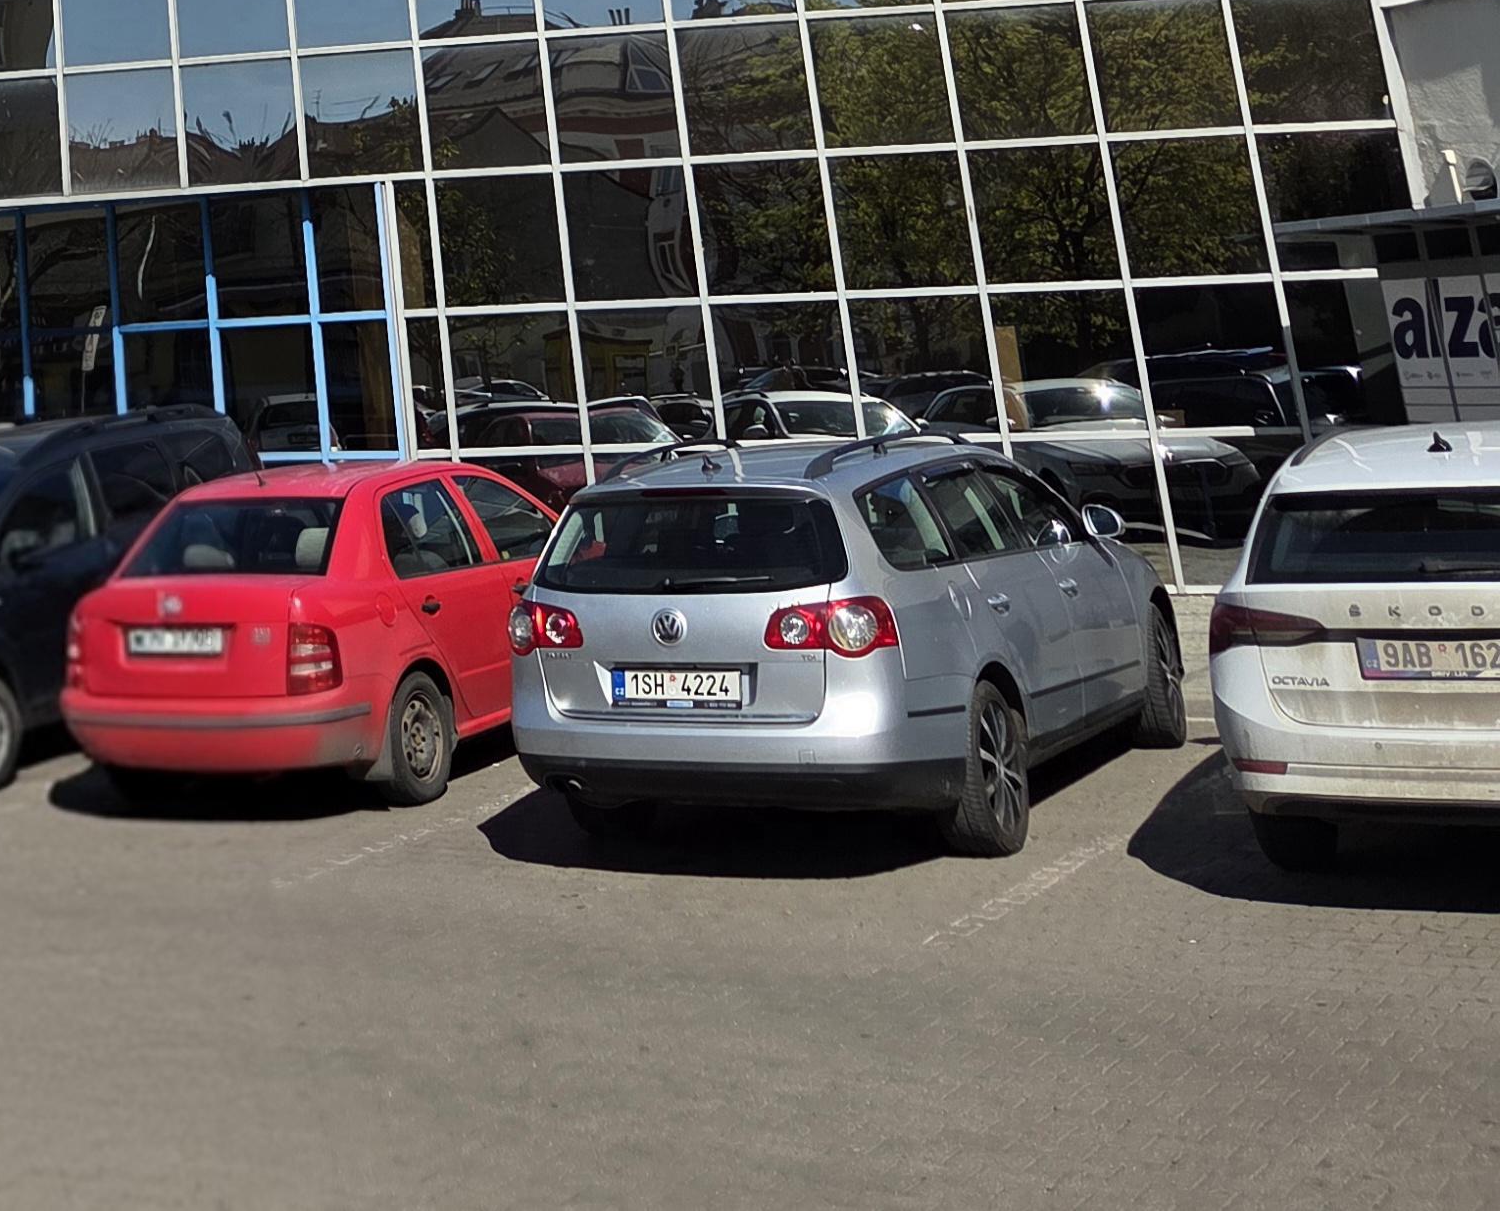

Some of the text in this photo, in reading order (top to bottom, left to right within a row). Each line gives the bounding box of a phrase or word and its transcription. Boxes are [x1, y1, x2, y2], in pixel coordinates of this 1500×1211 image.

[1382, 642, 1433, 669] 9AB
[631, 673, 731, 697] 1SH 4224
[1271, 675, 1331, 687] OCTAVIA
